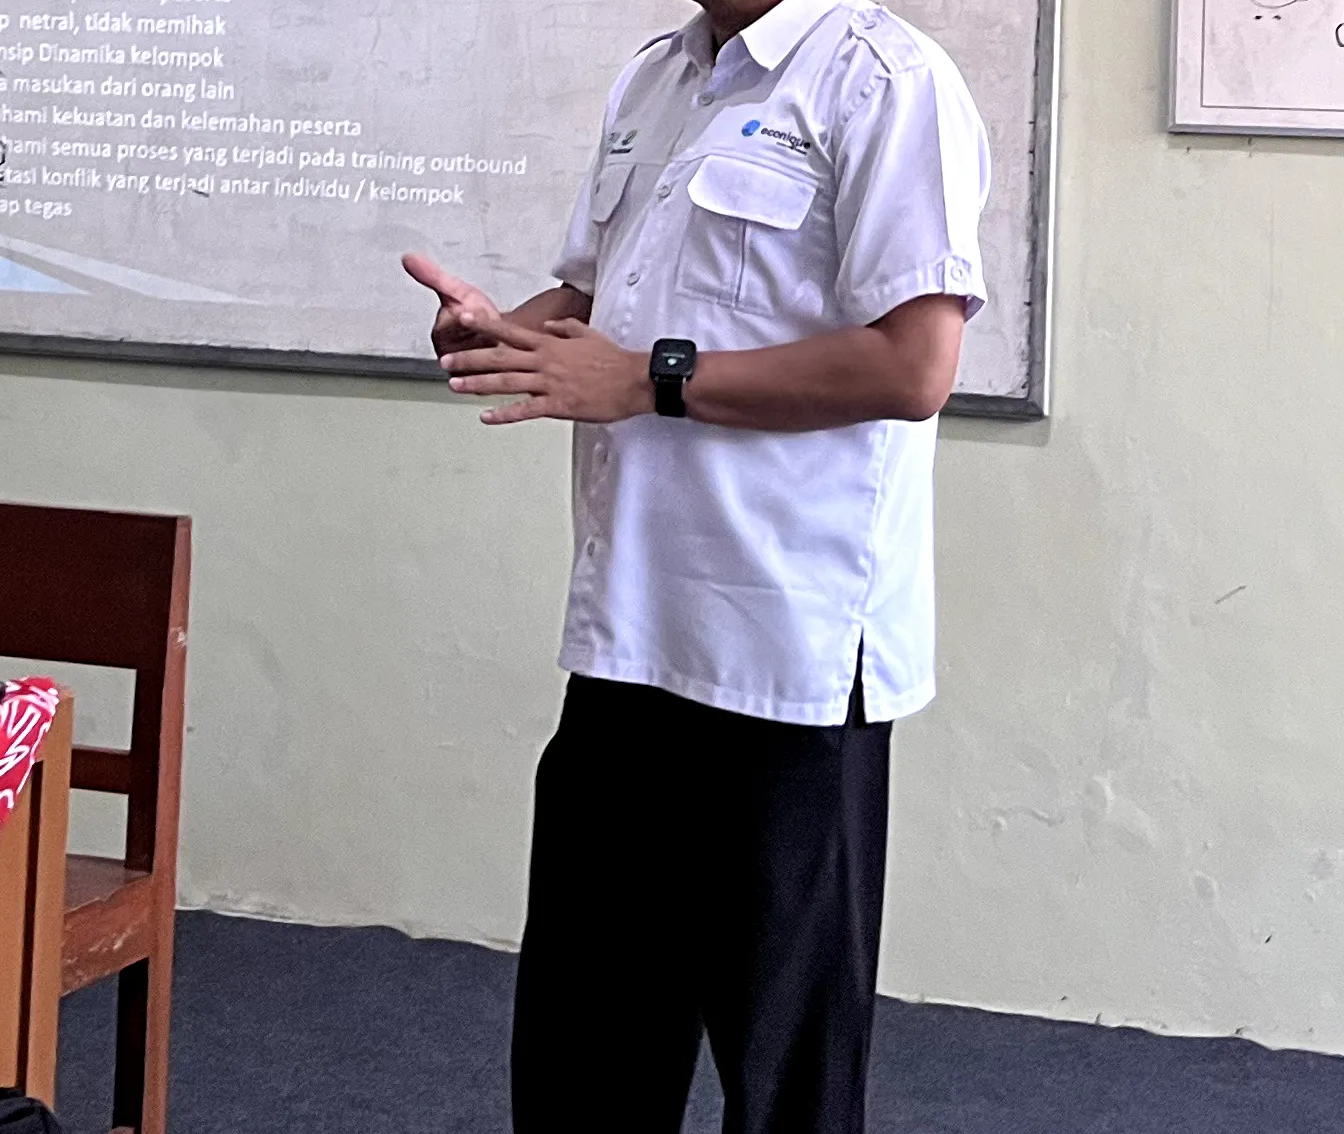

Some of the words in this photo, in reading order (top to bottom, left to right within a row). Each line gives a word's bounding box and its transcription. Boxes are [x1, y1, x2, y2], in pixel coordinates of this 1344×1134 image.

[19, 10, 81, 36] netral,
[84, 11, 133, 34] tidak
[137, 13, 226, 36] memihak
[38, 41, 126, 65] Dinamika
[130, 44, 225, 72] kelompok
[12, 73, 96, 97] masukan
[100, 74, 137, 97] dari
[141, 79, 197, 104] orang
[201, 77, 235, 101] lain
[52, 104, 136, 128] kekuatan
[140, 108, 176, 130] dan
[181, 109, 286, 135] kelemahan
[289, 117, 363, 140] peserta
[51, 140, 112, 159] semua
[116, 141, 179, 164] proses
[183, 145, 228, 167] yang
[231, 144, 294, 170] terjadi
[298, 146, 346, 171] pada
[350, 149, 427, 176] training
[430, 152, 528, 176] outbound
[41, 166, 102, 188] konflik
[106, 171, 151, 194] yang
[154, 173, 216, 196] terjadi
[219, 176, 270, 195] antar
[274, 177, 351, 200] individu
[353, 177, 367, 204] /
[369, 180, 465, 207] kelompok
[24, 198, 72, 220] tegas
